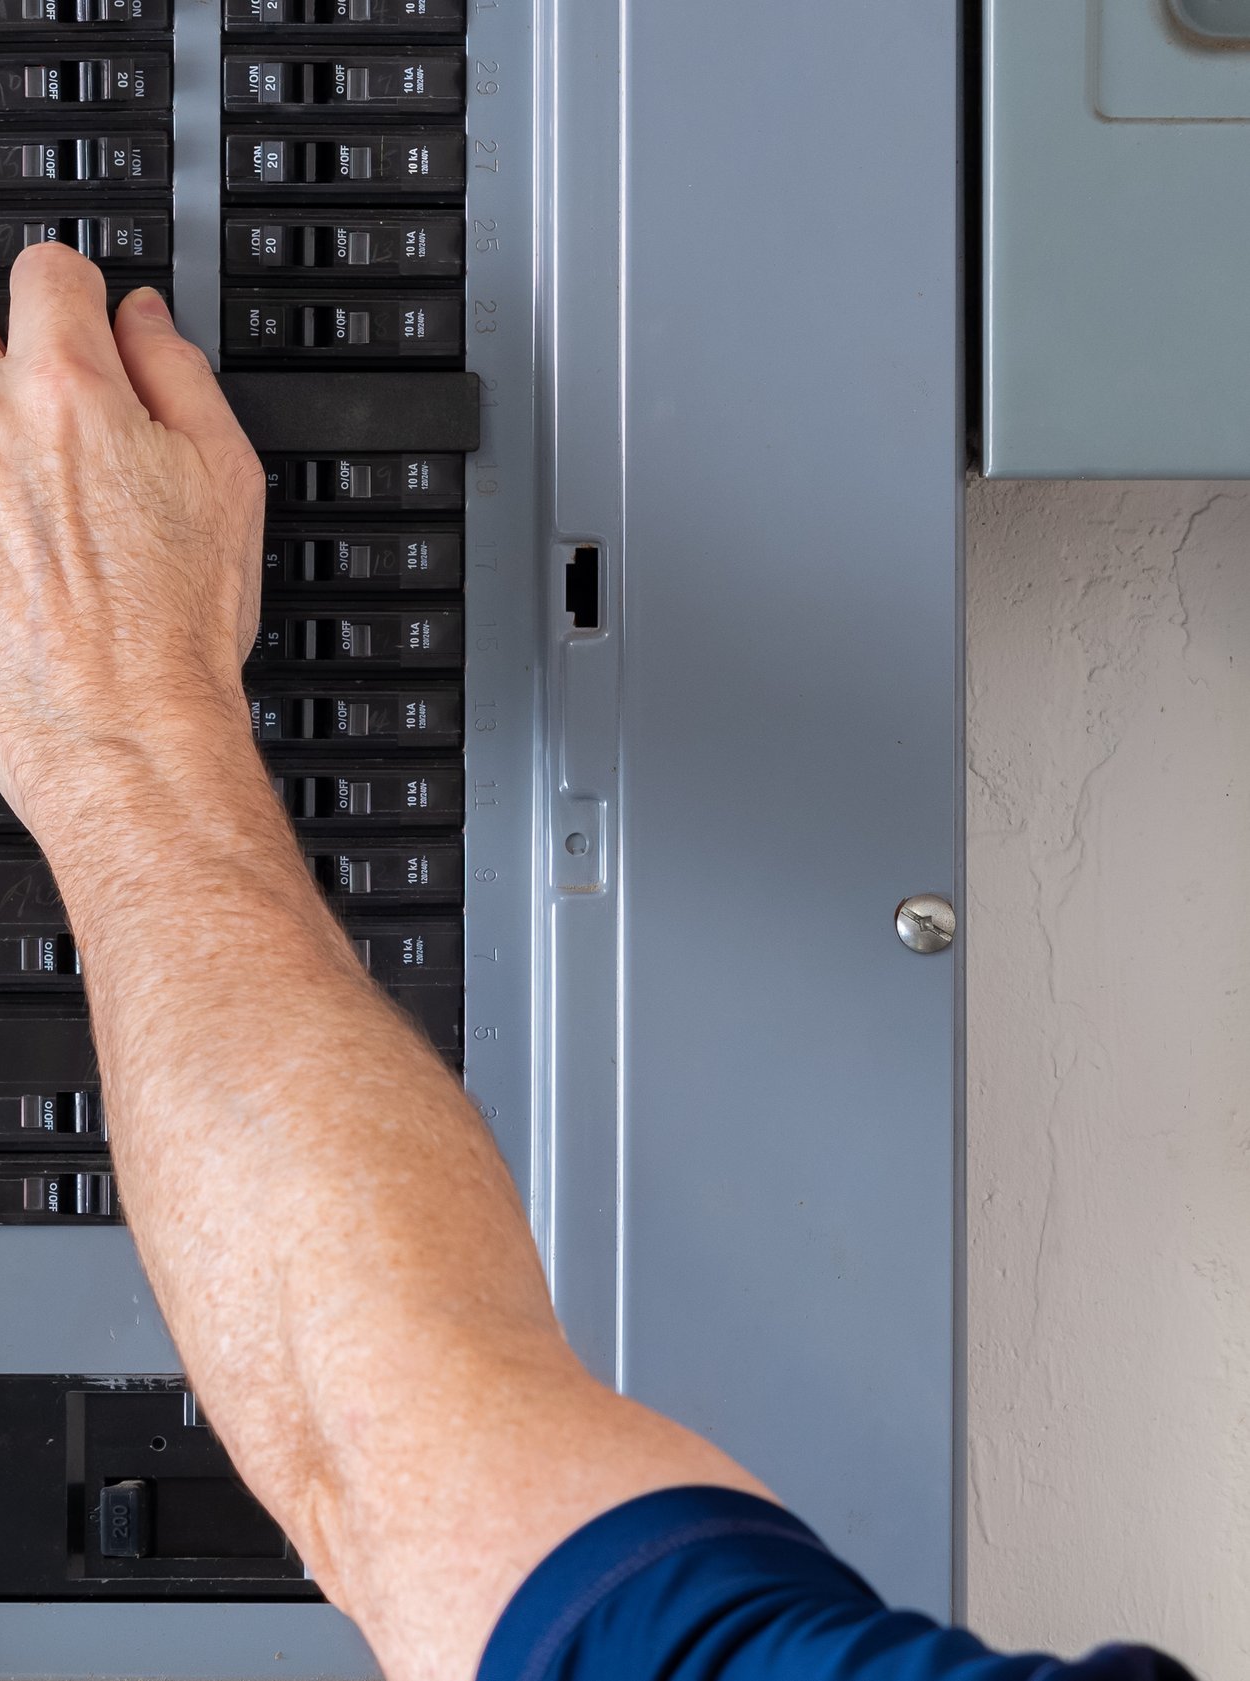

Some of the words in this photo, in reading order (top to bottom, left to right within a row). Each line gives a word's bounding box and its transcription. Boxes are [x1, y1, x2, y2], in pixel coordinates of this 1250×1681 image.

[118, 72, 128, 88] 20
[336, 64, 345, 94] O/OFF
[404, 67, 413, 79] kA
[49, 70, 58, 100] O/OFF
[265, 75, 276, 91] 20
[404, 80, 413, 93] 10
[114, 150, 124, 166] 20
[267, 152, 278, 168] 20
[341, 144, 350, 175] O/OFF
[409, 148, 417, 161] kA
[46, 149, 55, 179] O/OFF
[409, 162, 417, 174] 10
[117, 229, 127, 245] 20
[338, 228, 346, 258] O/OFF
[407, 231, 416, 243] kA
[266, 238, 276, 254] 20
[407, 244, 415, 257] 10
[337, 309, 346, 338] O/OFF
[405, 311, 414, 323] kA
[266, 319, 276, 335] 20
[405, 324, 414, 337] 10
[341, 460, 350, 490] O/OFF
[409, 463, 418, 475] kA
[268, 473, 278, 488] 15
[409, 476, 417, 489] 10
[267, 553, 277, 568] 15
[342, 620, 351, 650] O/OFF
[410, 622, 420, 635] kA
[269, 632, 279, 647] 15
[410, 636, 419, 649] 10
[407, 702, 416, 715] kA
[265, 711, 276, 727] 15
[407, 716, 416, 729] 10
[339, 779, 348, 808] O/OFF
[341, 856, 349, 885] O/OFF
[408, 857, 417, 870] kA
[408, 871, 417, 884] 10
[403, 938, 412, 950] kA
[403, 951, 412, 964] 10
[44, 1101, 53, 1130] O/OFF
[49, 1183, 58, 1212] O/OFF
[112, 1504, 128, 1538] 200
